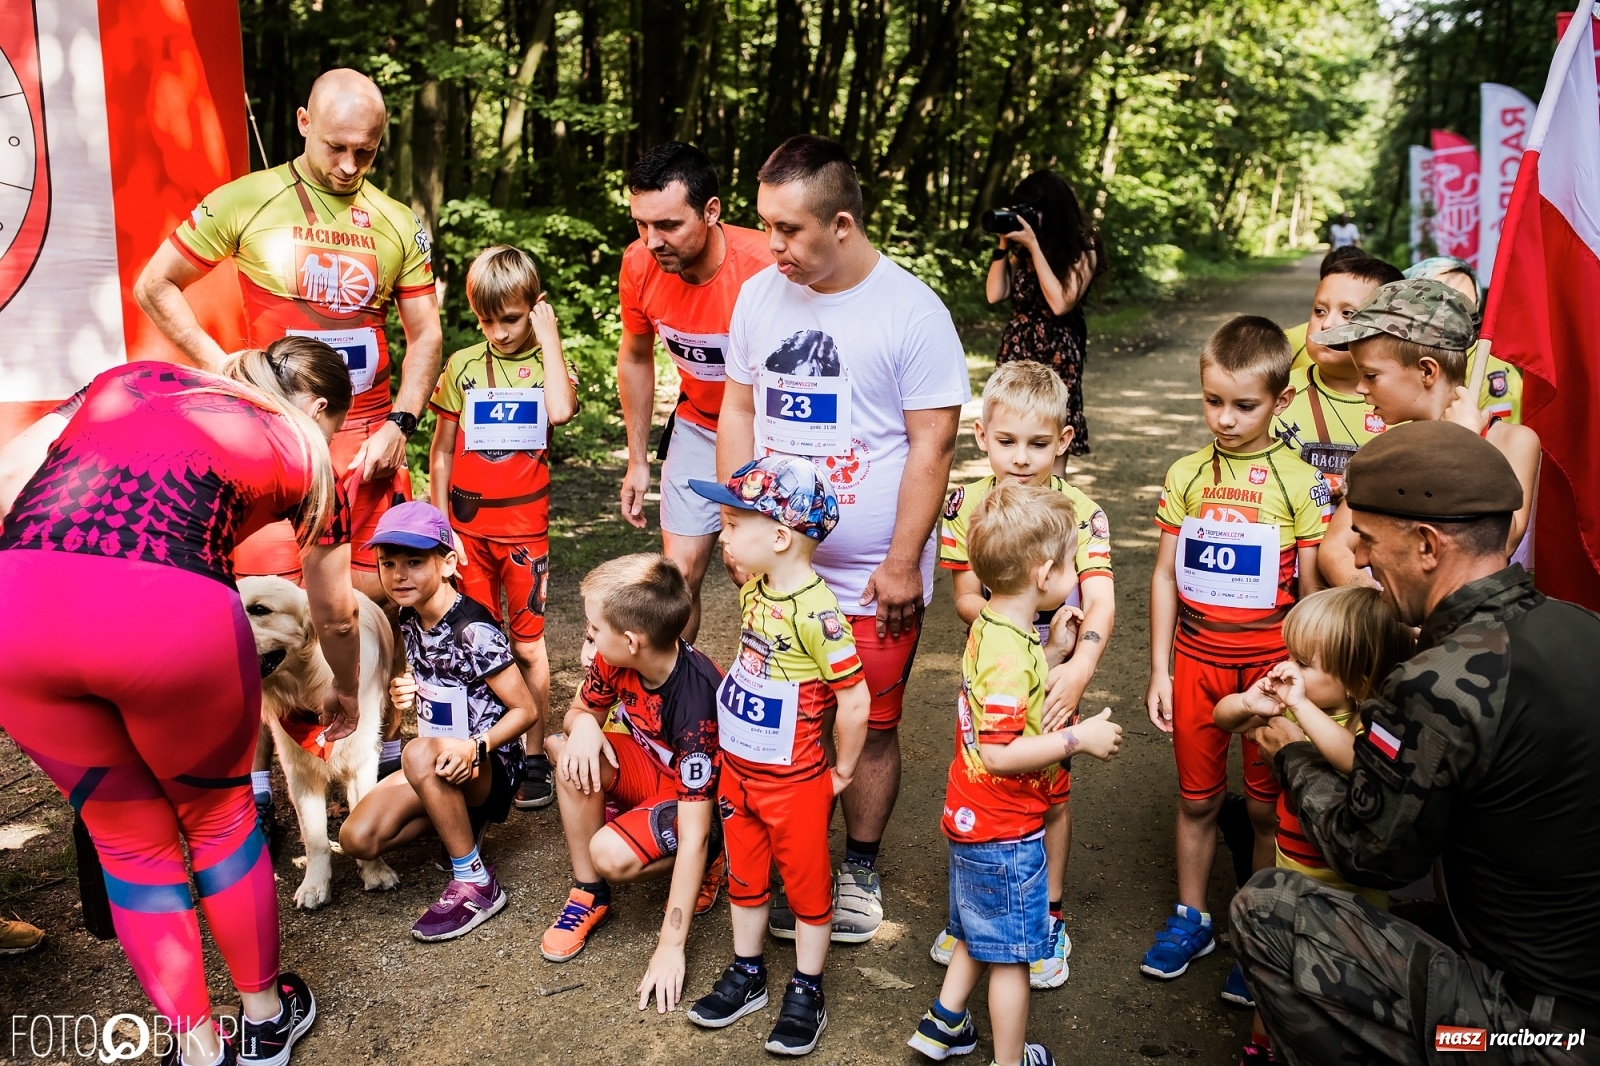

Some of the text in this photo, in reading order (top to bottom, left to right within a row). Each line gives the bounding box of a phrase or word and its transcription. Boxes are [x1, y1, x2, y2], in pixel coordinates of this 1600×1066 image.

[293, 226, 377, 251] RACIBORKI
[678, 345, 707, 362] 76
[489, 402, 520, 421] 47
[780, 393, 812, 419] 23
[1202, 486, 1263, 505] RACIBORKI
[1198, 545, 1236, 571] 40
[416, 695, 433, 720] 96
[727, 683, 765, 722] 113
[689, 763, 703, 780] B
